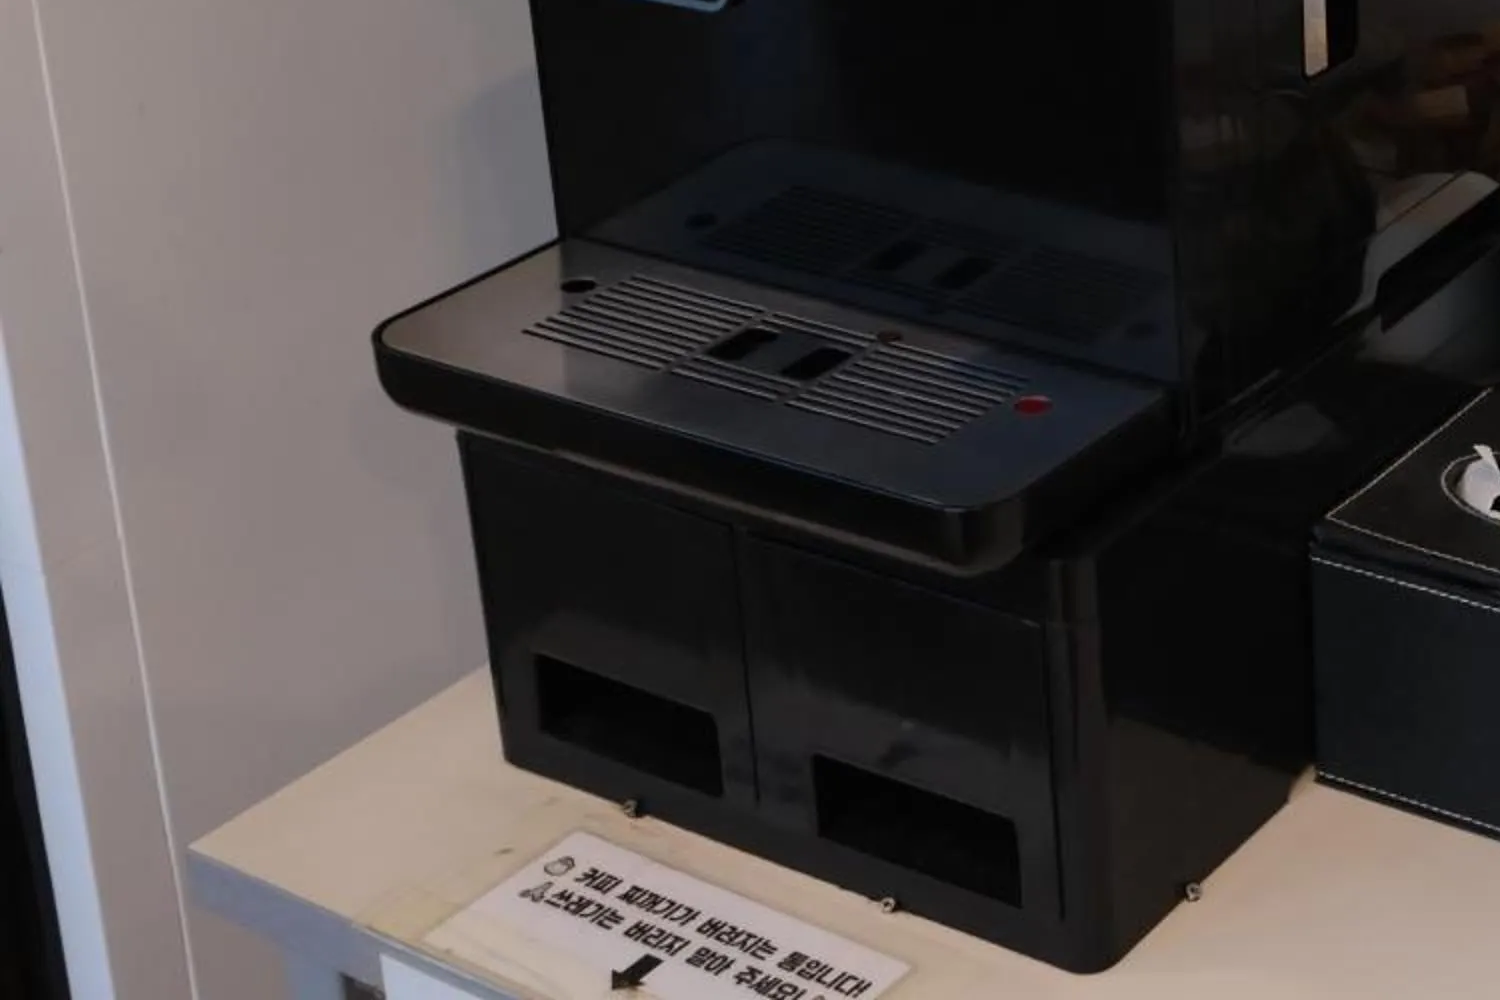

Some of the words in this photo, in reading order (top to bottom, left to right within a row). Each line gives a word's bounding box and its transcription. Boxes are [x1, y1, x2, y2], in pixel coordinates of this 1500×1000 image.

[544, 888, 625, 930] 쓰레기는
[623, 919, 692, 957] 버리지
[685, 946, 736, 976] 말아
[573, 866, 624, 895] 커피
[616, 885, 701, 927] 찌꺼기가
[695, 917, 778, 960] 버려지는
